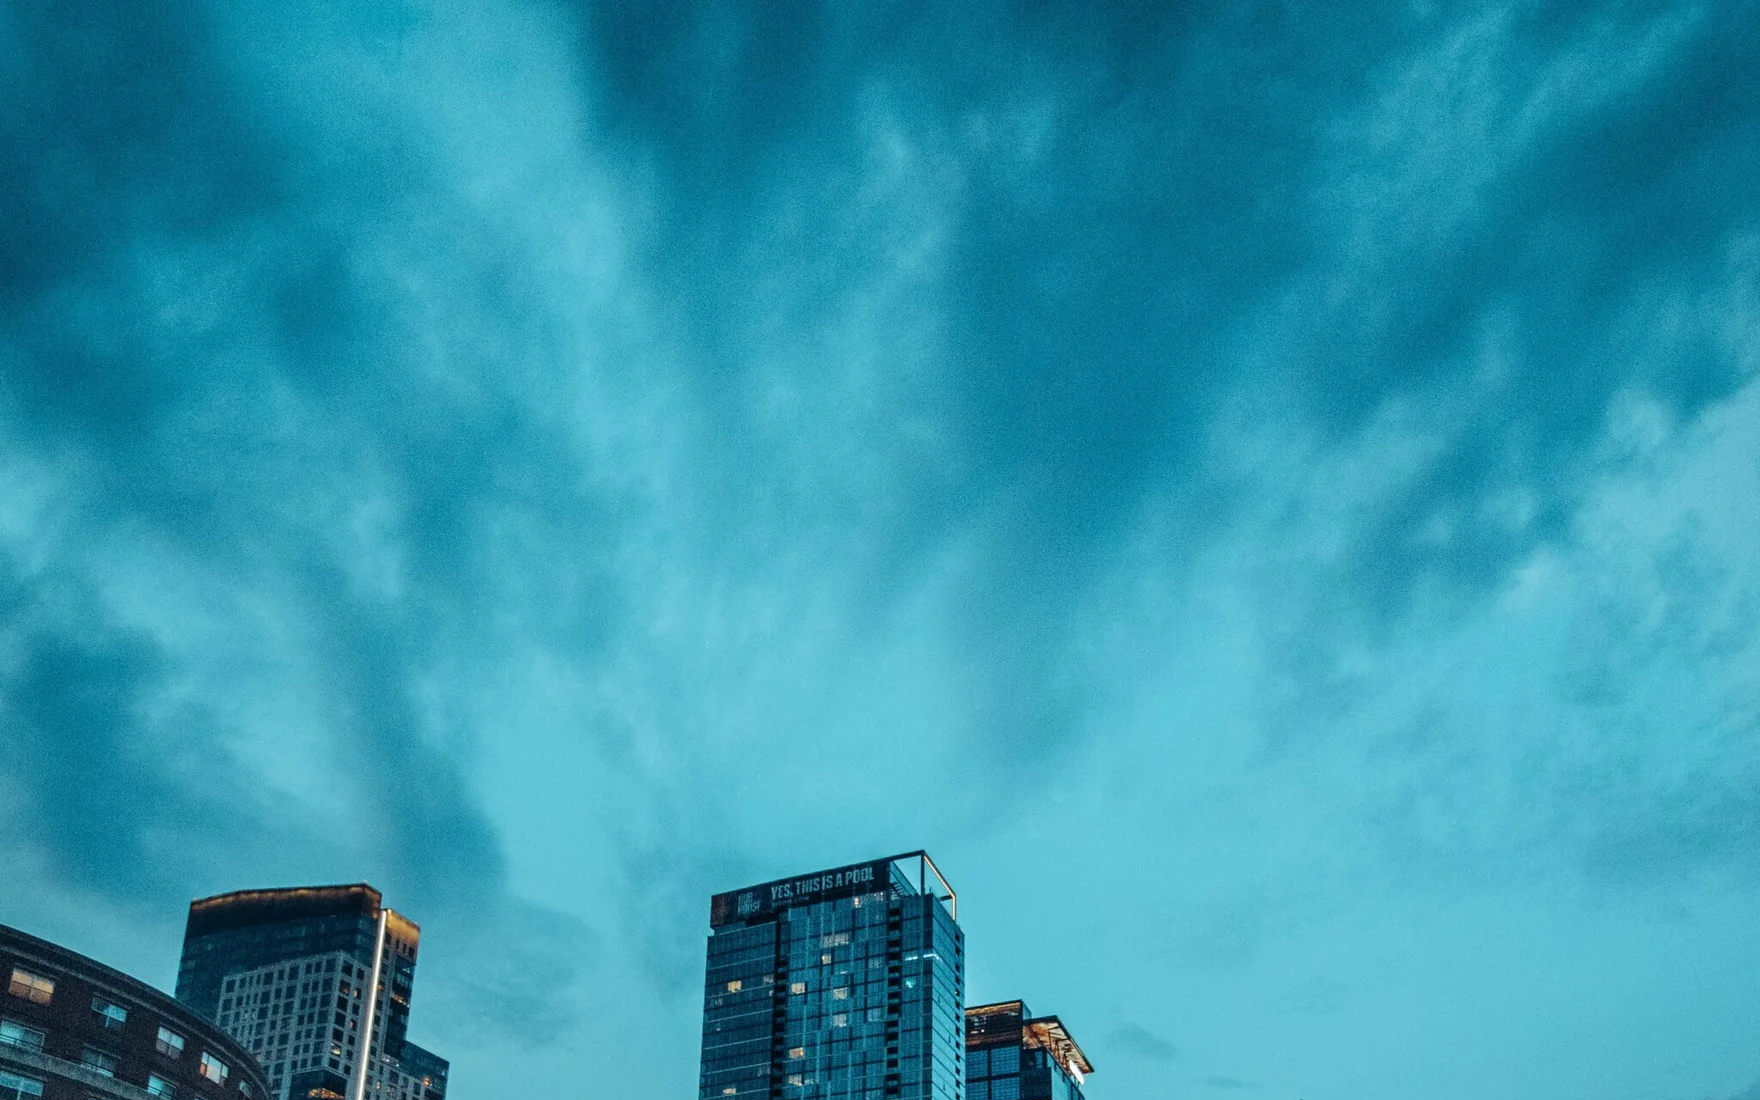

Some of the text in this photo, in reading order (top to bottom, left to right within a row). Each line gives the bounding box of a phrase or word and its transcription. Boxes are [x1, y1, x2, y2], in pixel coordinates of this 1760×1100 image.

[771, 867, 875, 900] YES, THIS IS A POOL
